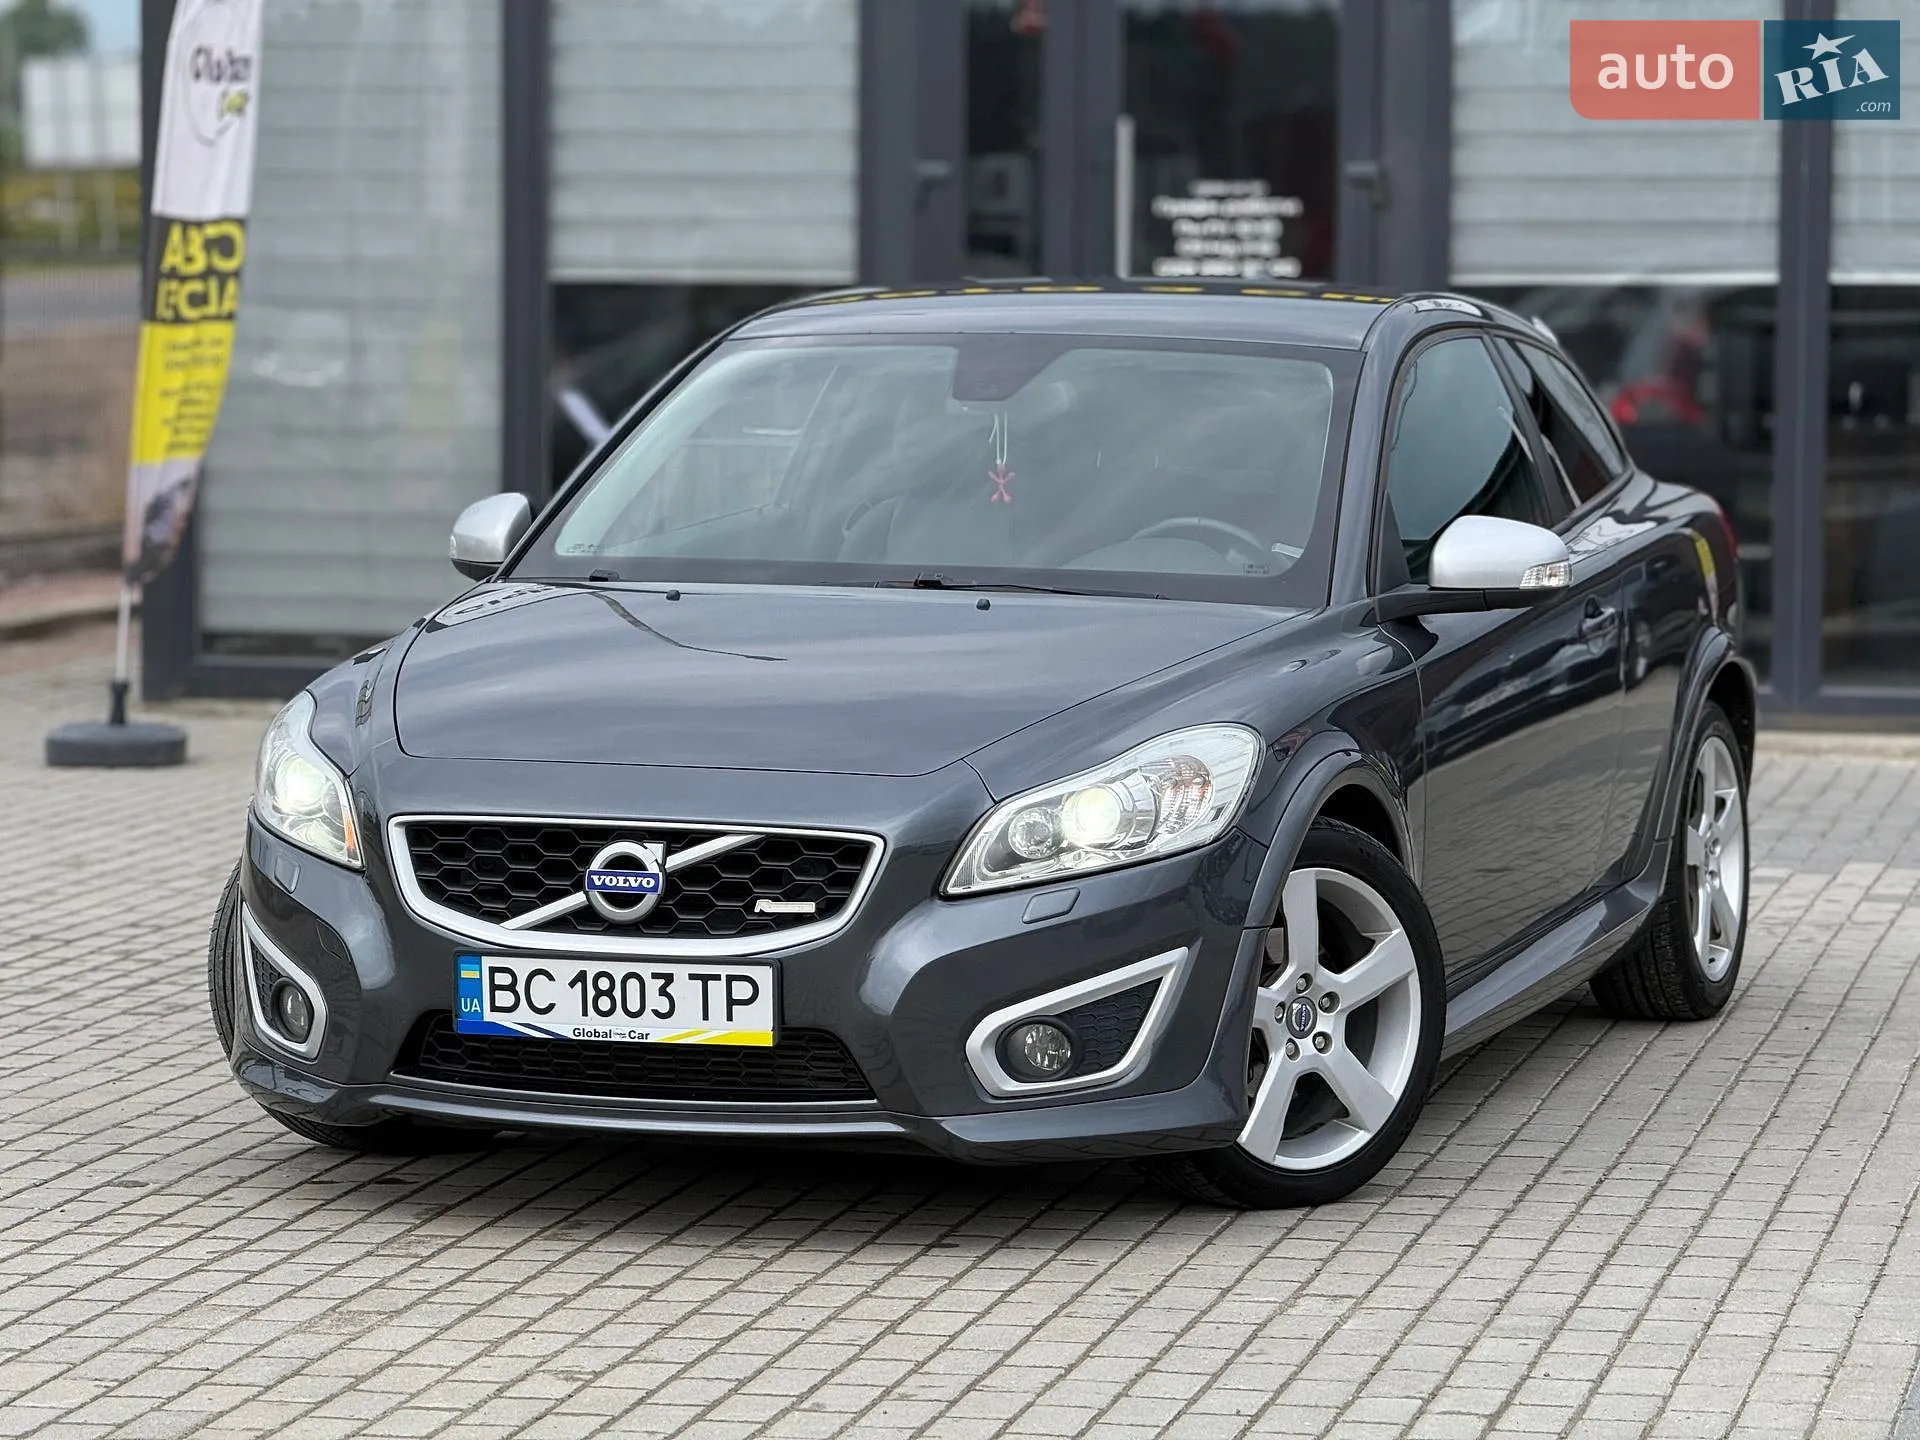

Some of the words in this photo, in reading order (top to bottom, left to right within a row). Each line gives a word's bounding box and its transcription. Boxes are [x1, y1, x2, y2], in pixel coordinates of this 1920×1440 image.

[590, 874, 656, 888] VOLVO
[488, 965, 556, 1016] BC
[567, 969, 676, 1020] 1803
[688, 972, 760, 1022] TP
[461, 997, 481, 1013] UA
[572, 1027, 612, 1039] Global
[628, 1030, 650, 1040] Car
